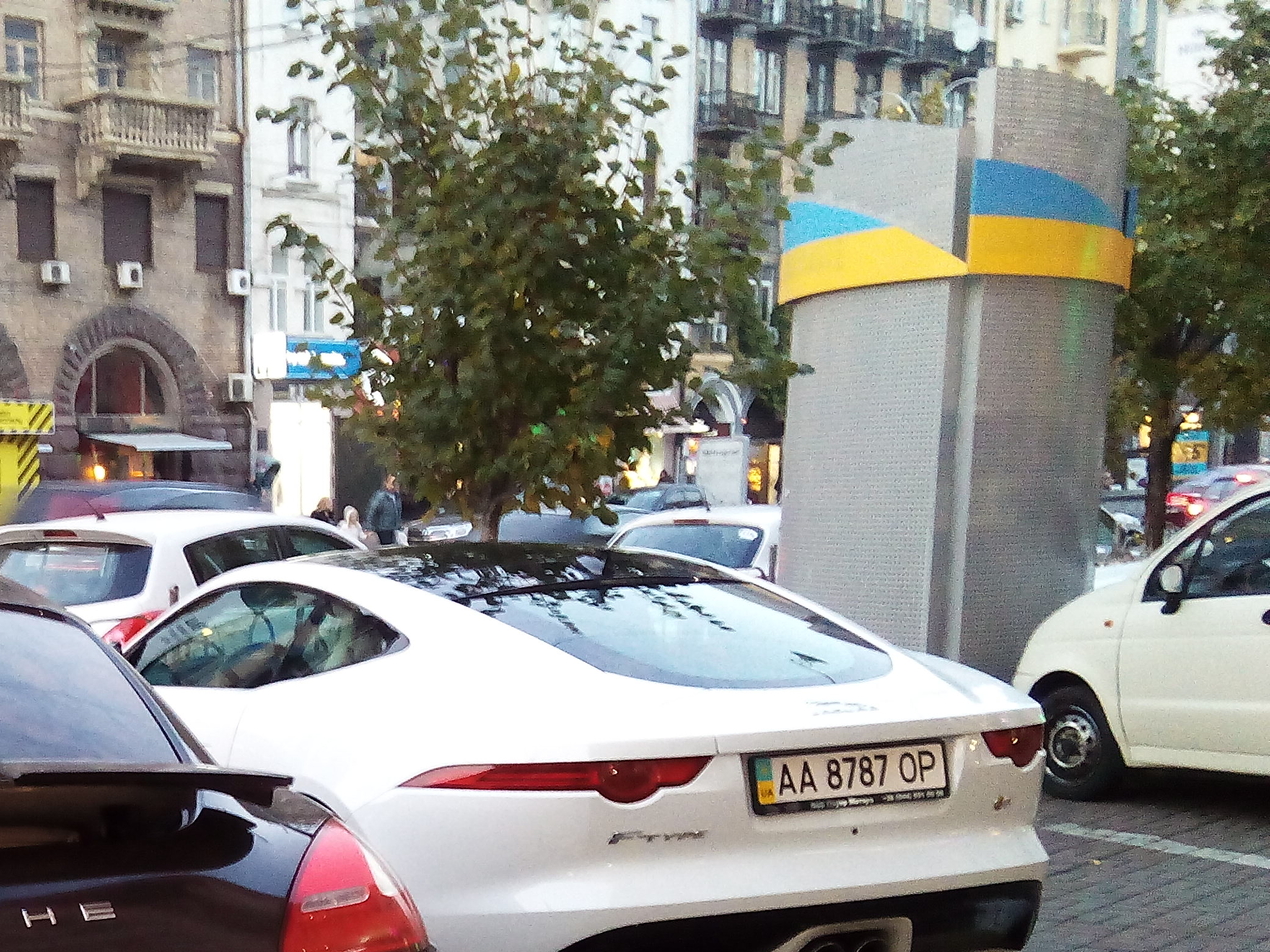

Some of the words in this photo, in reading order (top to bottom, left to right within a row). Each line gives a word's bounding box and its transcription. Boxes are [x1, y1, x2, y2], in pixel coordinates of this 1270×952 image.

[779, 761, 818, 796] AA
[826, 753, 888, 791] 8787
[899, 750, 936, 783] OP
